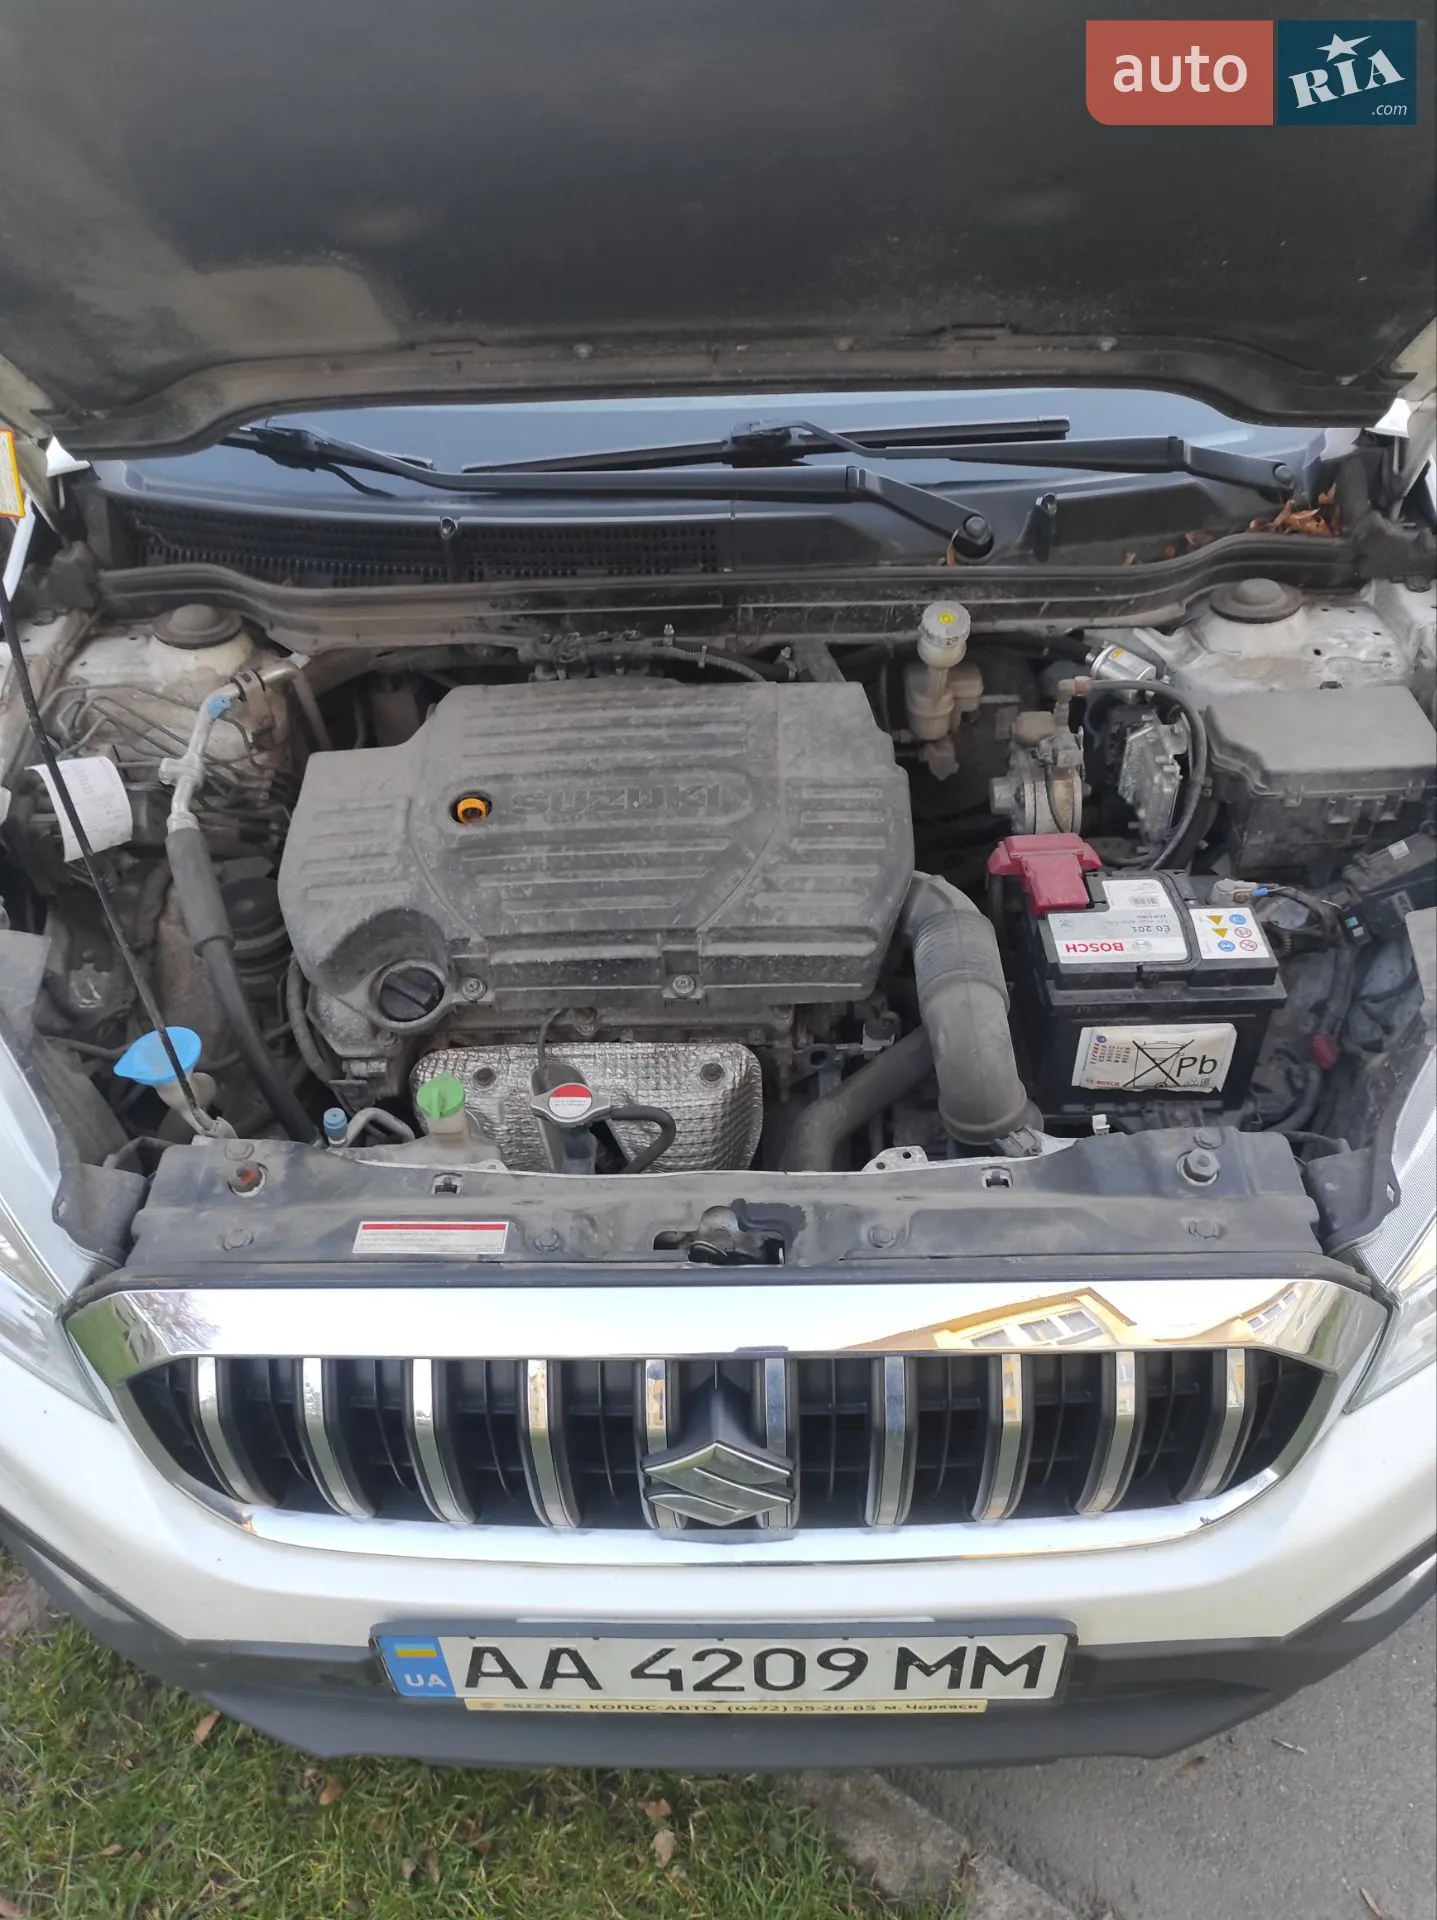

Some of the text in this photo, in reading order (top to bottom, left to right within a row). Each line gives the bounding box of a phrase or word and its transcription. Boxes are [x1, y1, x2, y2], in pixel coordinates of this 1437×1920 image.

[512, 784, 721, 815] SUZUKI
[1065, 942, 1125, 954] BOSCH
[1176, 1055, 1218, 1078] Pb
[1095, 1079, 1120, 1087] BOSCH
[465, 1645, 1046, 1692] AA 4209 MM
[404, 1673, 447, 1688] UA
